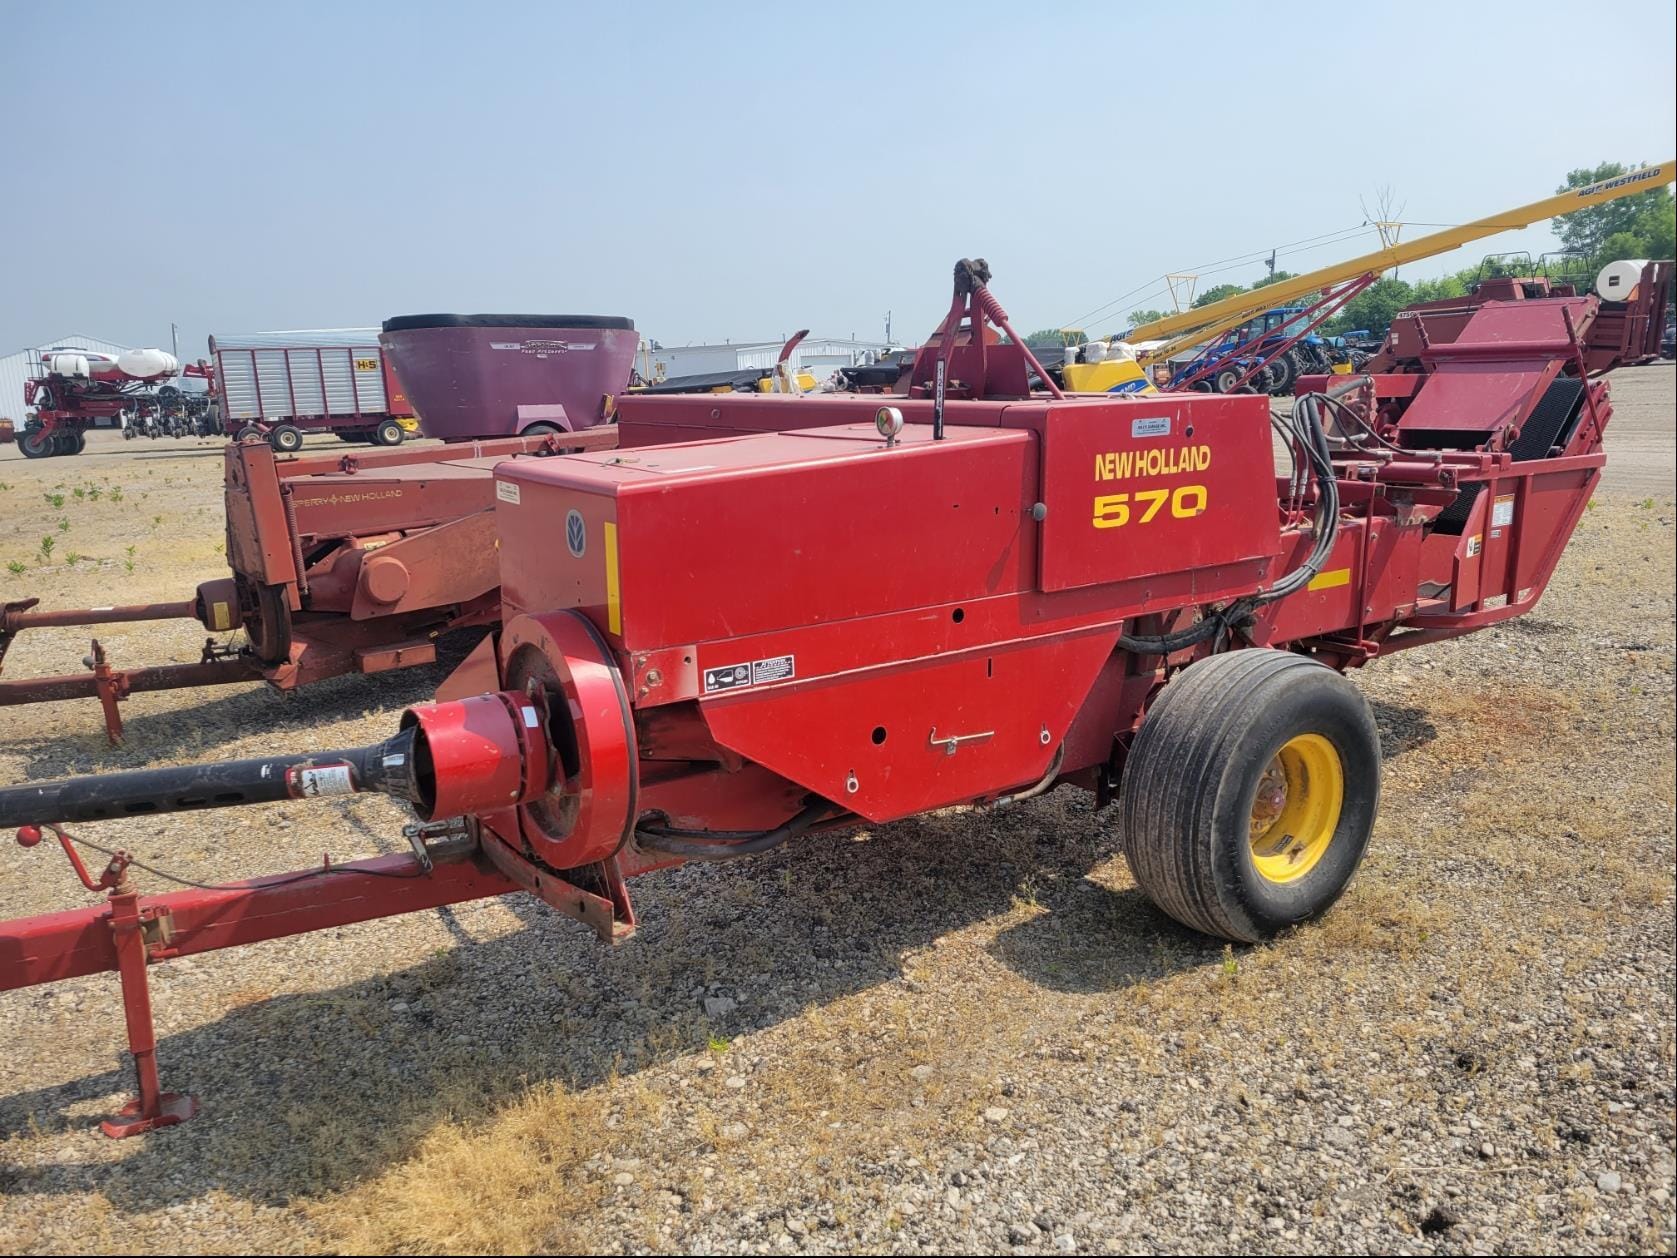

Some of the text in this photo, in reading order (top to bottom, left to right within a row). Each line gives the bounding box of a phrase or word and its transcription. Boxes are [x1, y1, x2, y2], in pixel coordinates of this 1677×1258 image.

[1605, 168, 1661, 189] WESTFIELD
[1095, 445, 1211, 481] NEW HOLLAND
[339, 494, 360, 503] NEW
[361, 489, 403, 500] HOLLAND
[1092, 485, 1208, 529] 570
